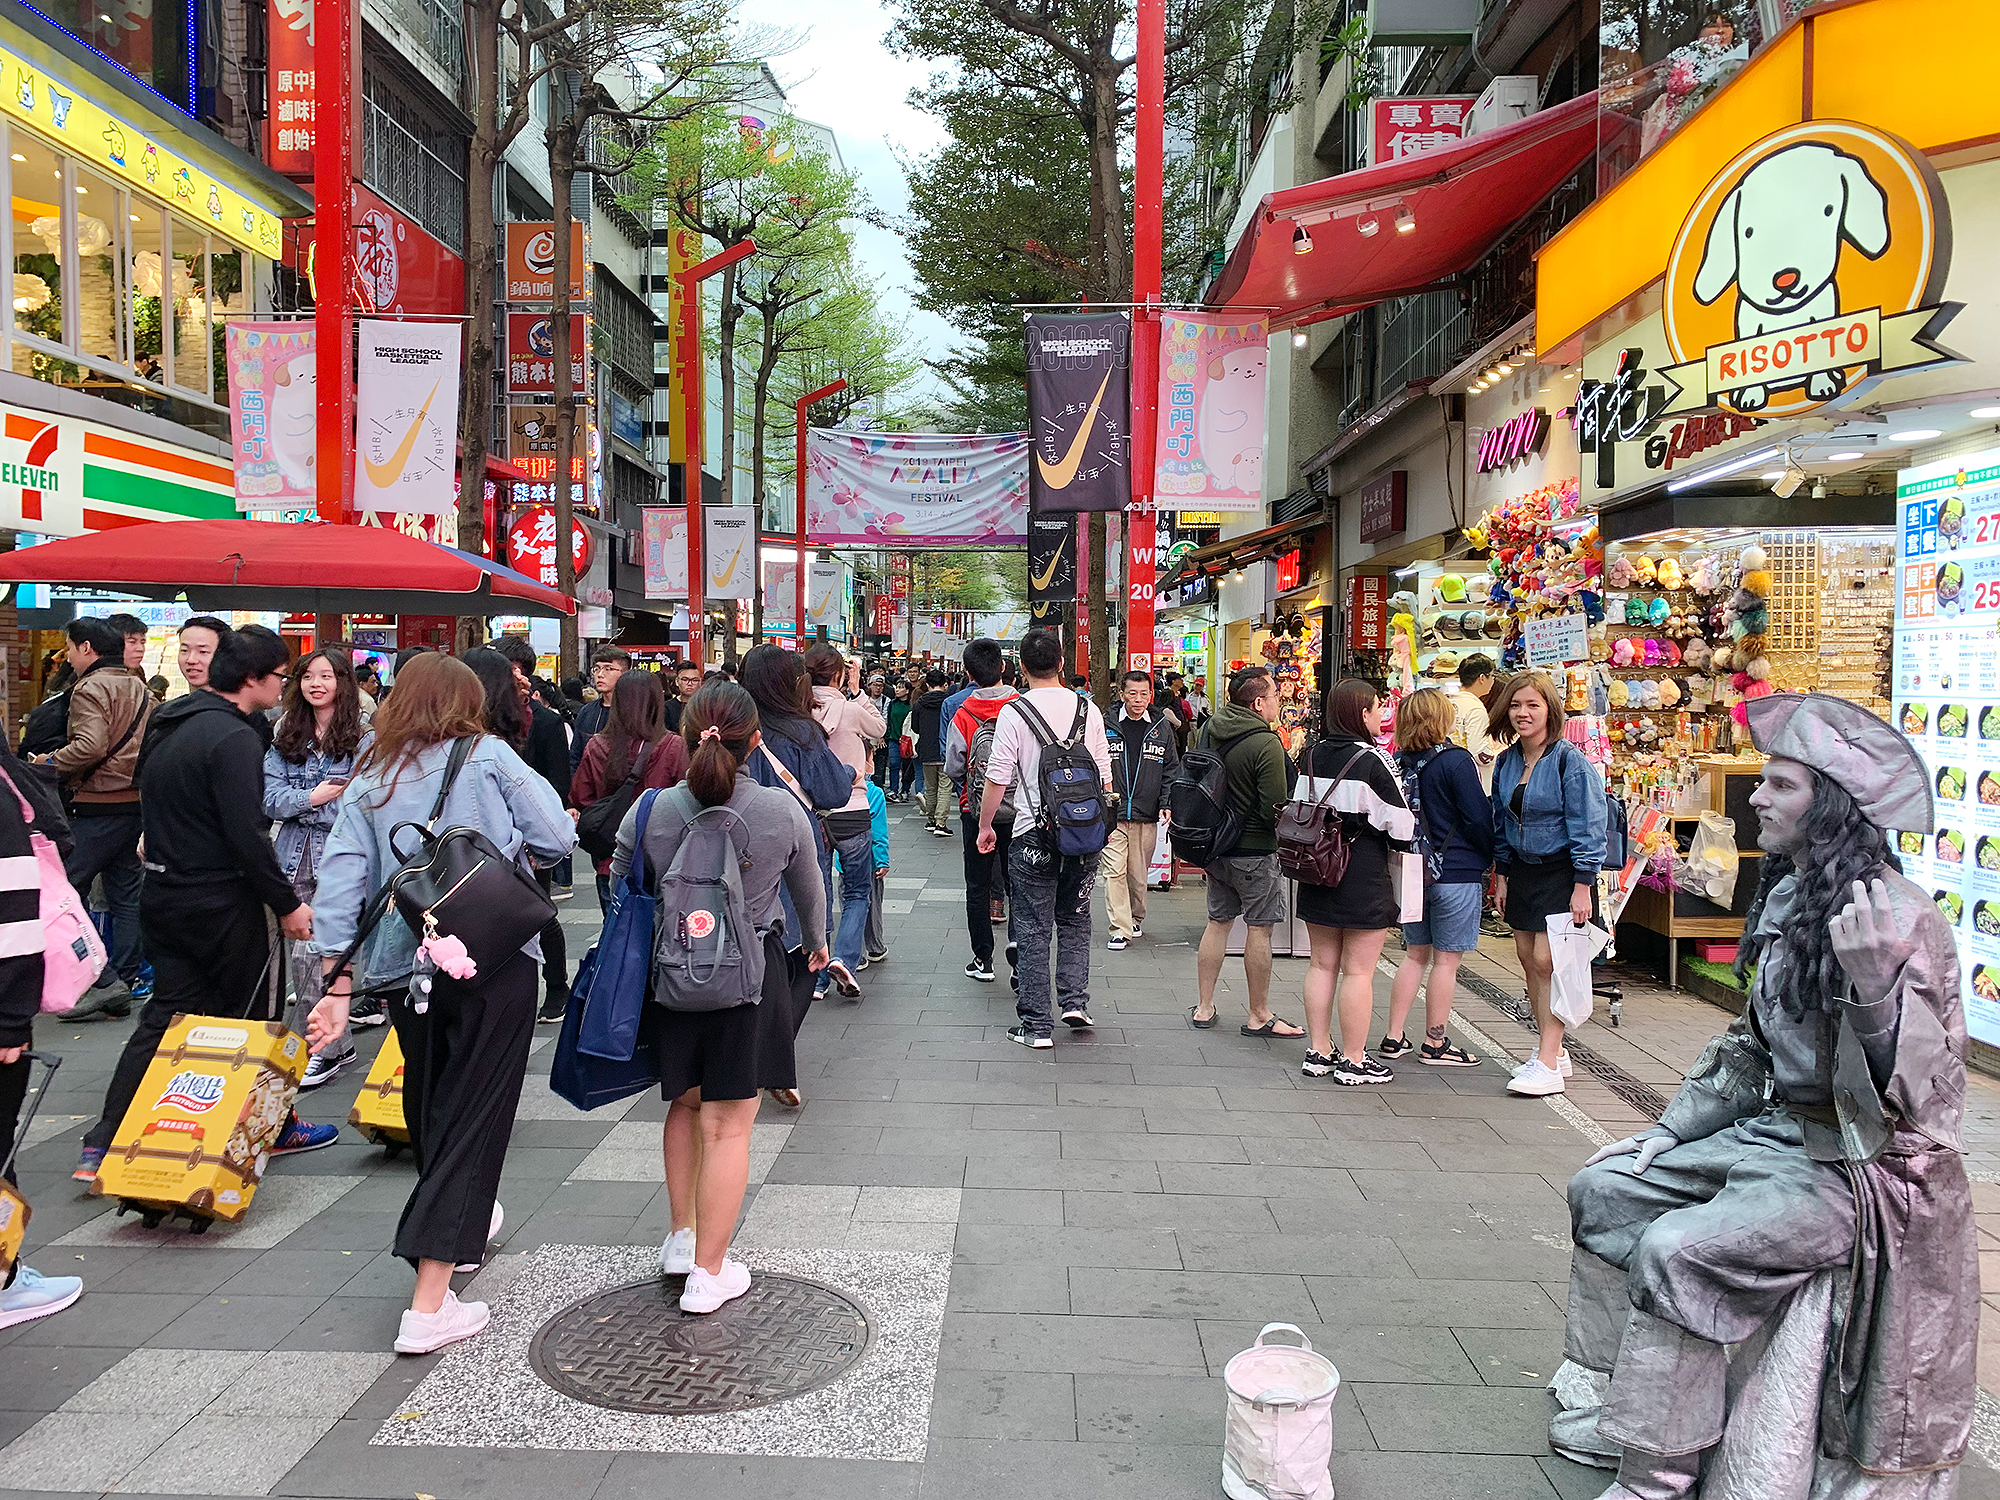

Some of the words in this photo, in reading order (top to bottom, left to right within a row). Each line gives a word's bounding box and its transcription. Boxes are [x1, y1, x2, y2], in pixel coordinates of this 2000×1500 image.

[1389, 104, 1462, 127] 專賣
[375, 351, 442, 360] BASKETBALL
[401, 347, 443, 355] SCHOOL
[1720, 322, 1868, 382] RISOTTO
[390, 357, 429, 365] LEAGUE
[240, 390, 266, 460] 西門町
[1167, 383, 1195, 457] 西門町
[902, 457, 928, 466] 2019
[889, 466, 982, 484] AZALEA
[1907, 503, 1937, 527] 坐下
[1906, 530, 1936, 554] 套餐
[1133, 547, 1152, 565] W
[1906, 566, 1935, 588] 握手
[1130, 584, 1153, 601] 20
[1905, 593, 1934, 615] 套餐
[690, 614, 700, 623] W
[1078, 617, 1088, 627] W
[1361, 577, 1378, 650] 國民旅遊卡
[690, 631, 700, 639] 17
[1078, 635, 1089, 643] 18
[1143, 742, 1166, 756] Line
